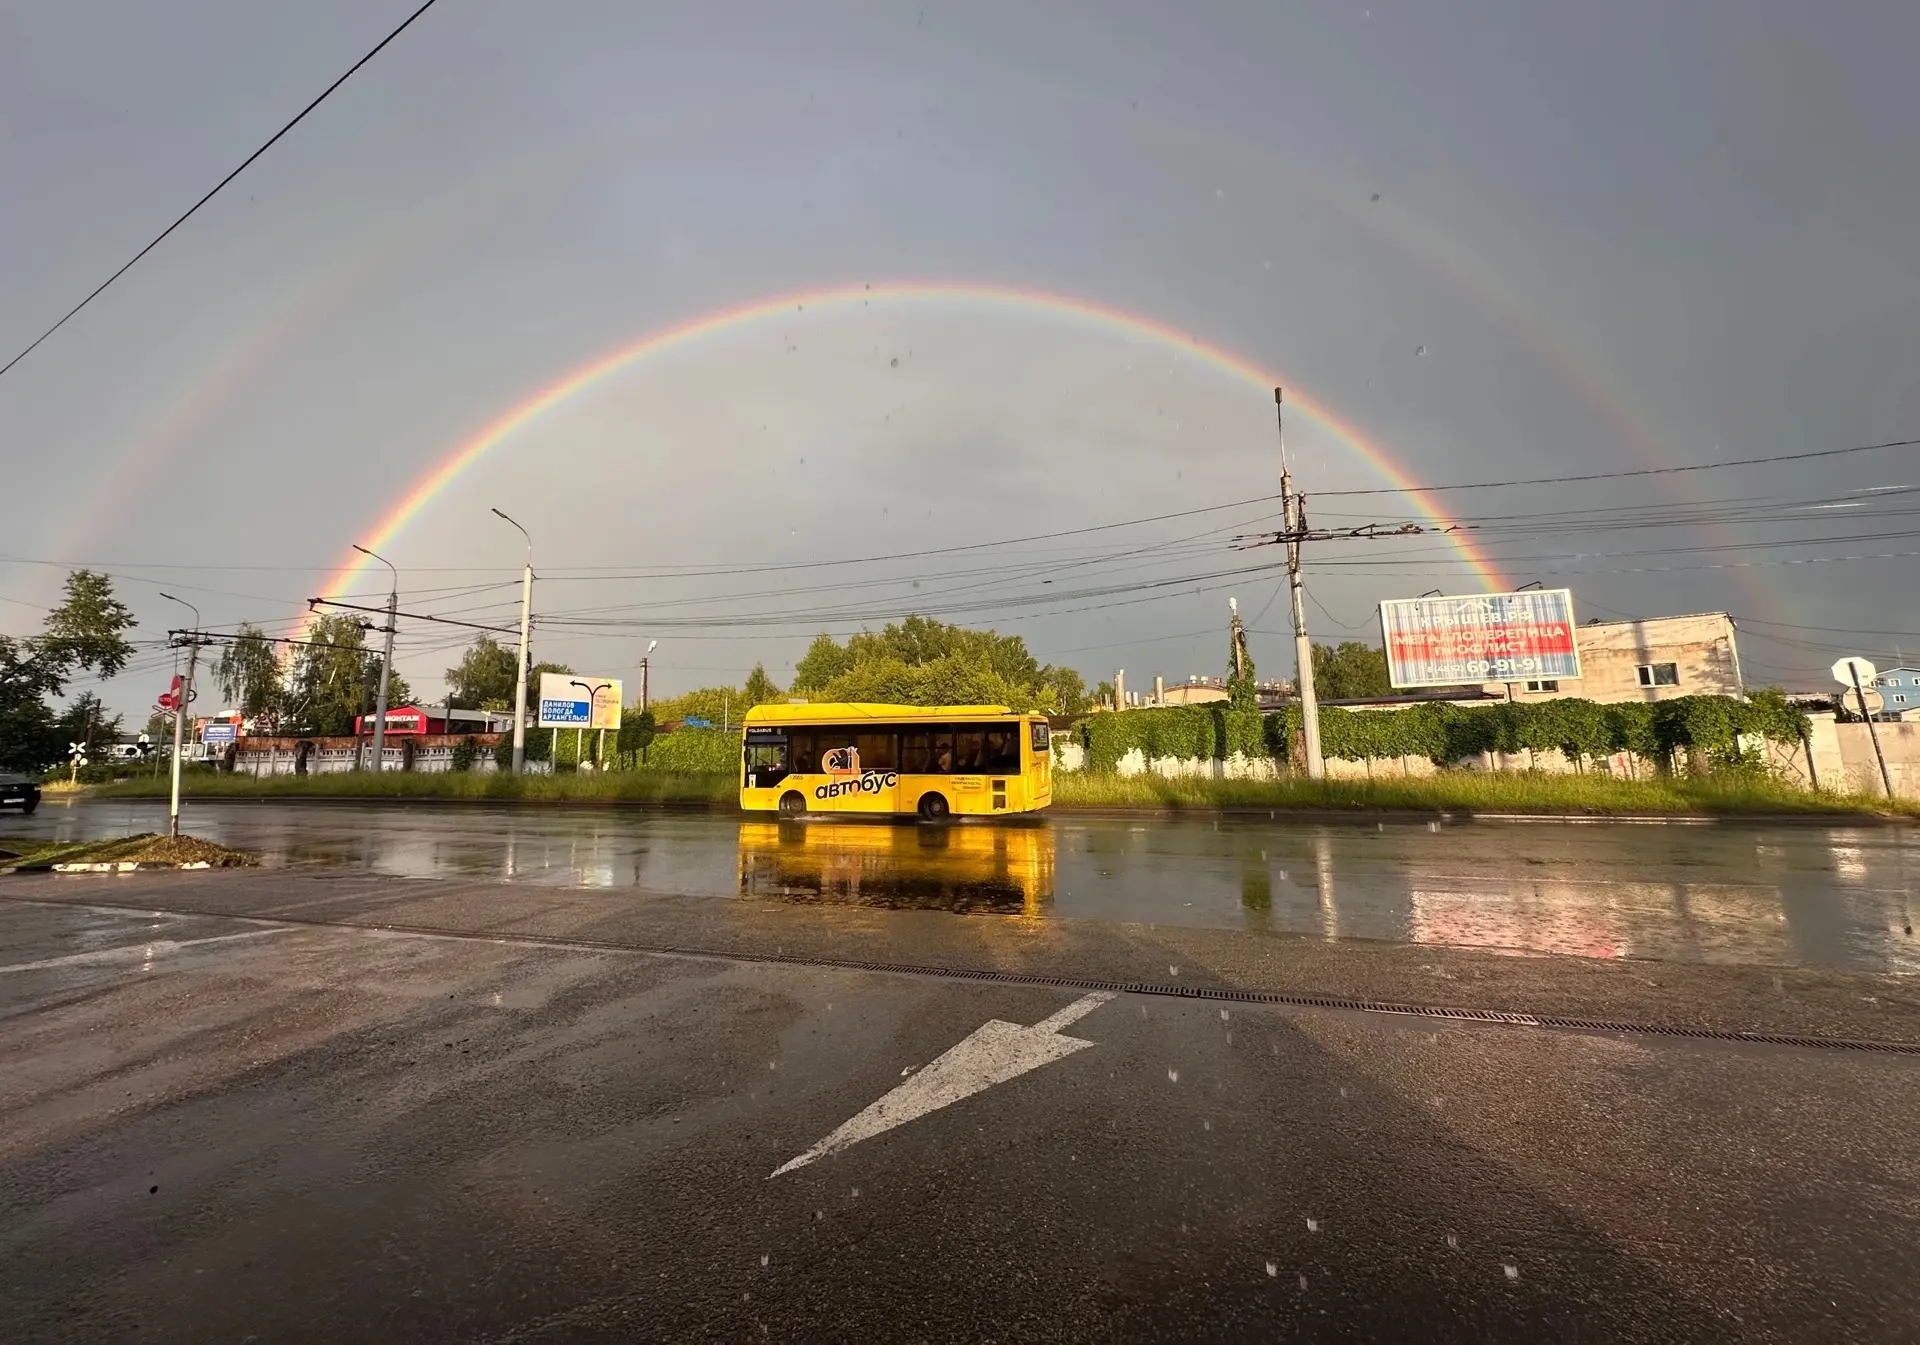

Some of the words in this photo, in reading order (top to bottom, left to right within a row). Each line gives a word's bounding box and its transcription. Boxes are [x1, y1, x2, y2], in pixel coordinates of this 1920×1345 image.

[1467, 657, 1542, 674] 60-91-91
[543, 707, 573, 715] ВОЛОГДА
[815, 771, 897, 799] автобус
